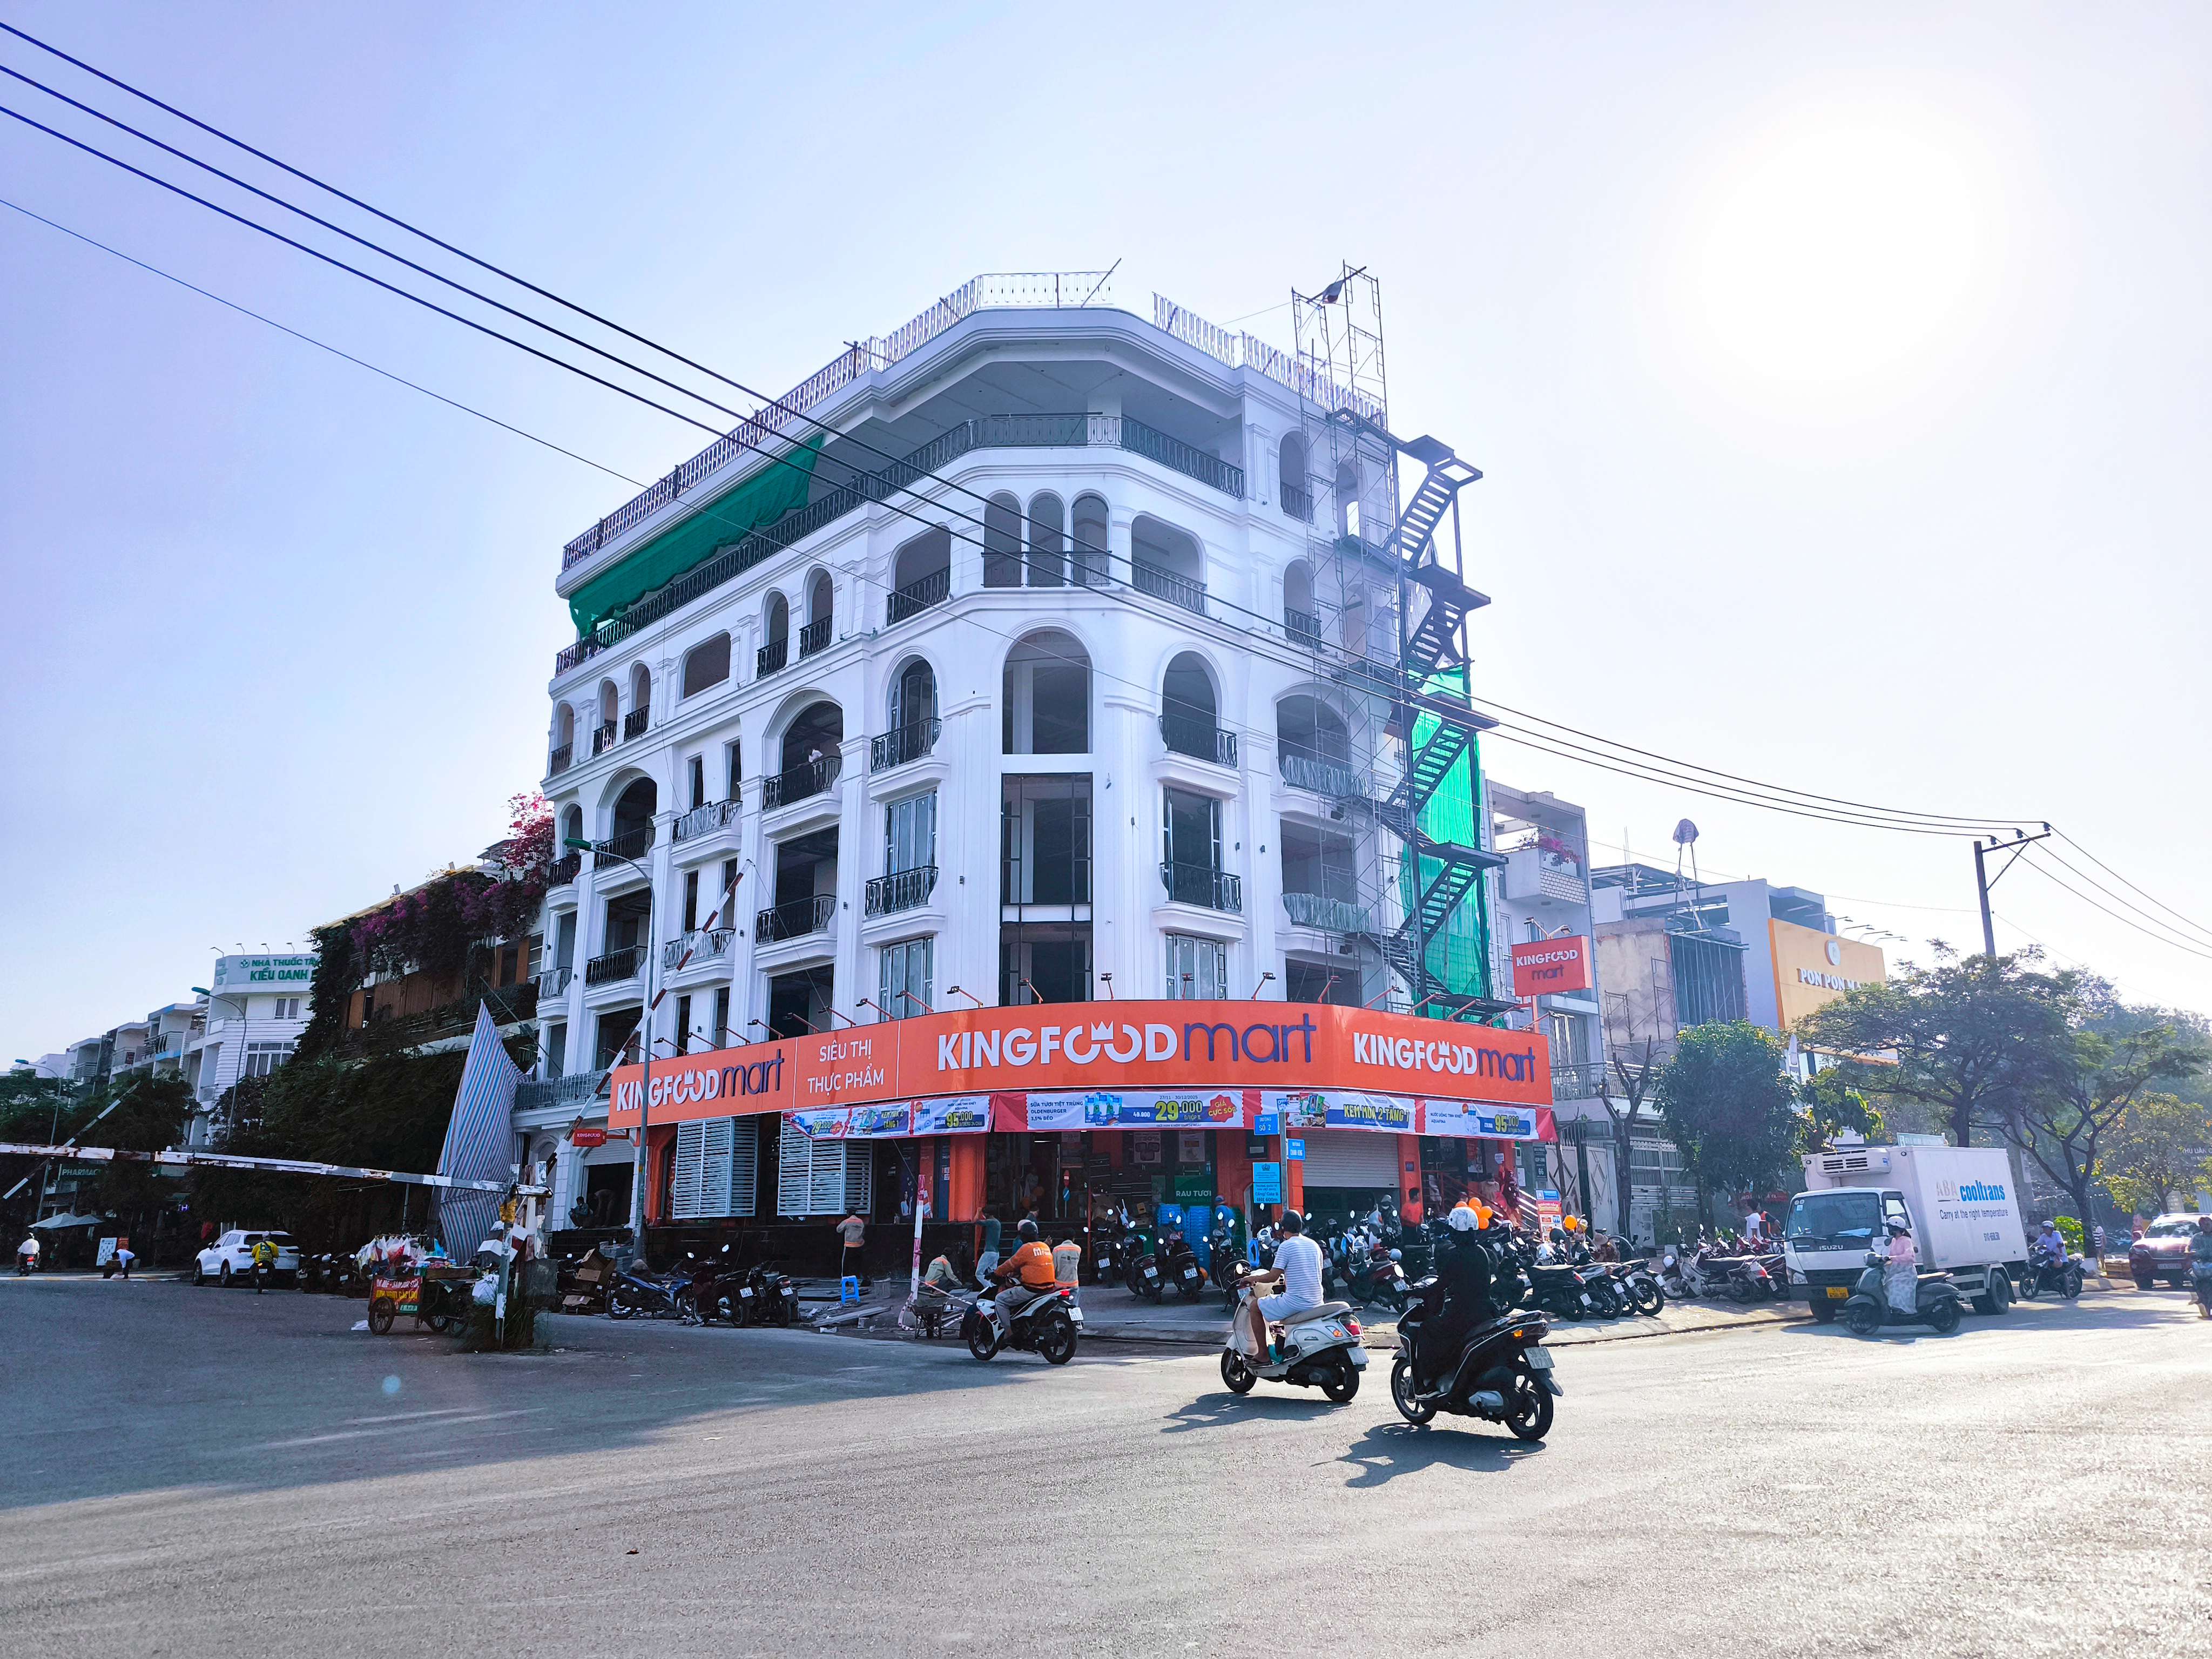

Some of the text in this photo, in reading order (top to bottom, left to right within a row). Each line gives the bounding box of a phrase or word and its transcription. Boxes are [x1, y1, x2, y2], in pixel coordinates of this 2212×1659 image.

[252, 957, 270, 966] NHÀ
[273, 956, 302, 966] THUỐC
[1516, 949, 1579, 966] KINGFOOD
[250, 967, 308, 981] KIỀU OANH
[1532, 964, 1564, 981] mart
[1798, 967, 1823, 987] PON
[1824, 973, 1846, 992] PON
[819, 1039, 872, 1062] SIÊU THỊ
[808, 1063, 884, 1097] THỰC PHẨM
[900, 1109, 904, 1117] 2
[946, 1111, 973, 1127] 95.000
[1155, 1100, 1203, 1121] 29.000
[1344, 1104, 1360, 1118] KEM
[1378, 1108, 1384, 1120] 2
[1385, 1105, 1404, 1124] TẶNG
[1406, 1110, 1410, 1122] 1
[1259, 1123, 1266, 1131] SỐ
[1494, 1114, 1520, 1132] 95.000
[1936, 1180, 2005, 1202] ABA cooltrans
[1939, 1208, 2008, 1222] Carry at the right temperature
